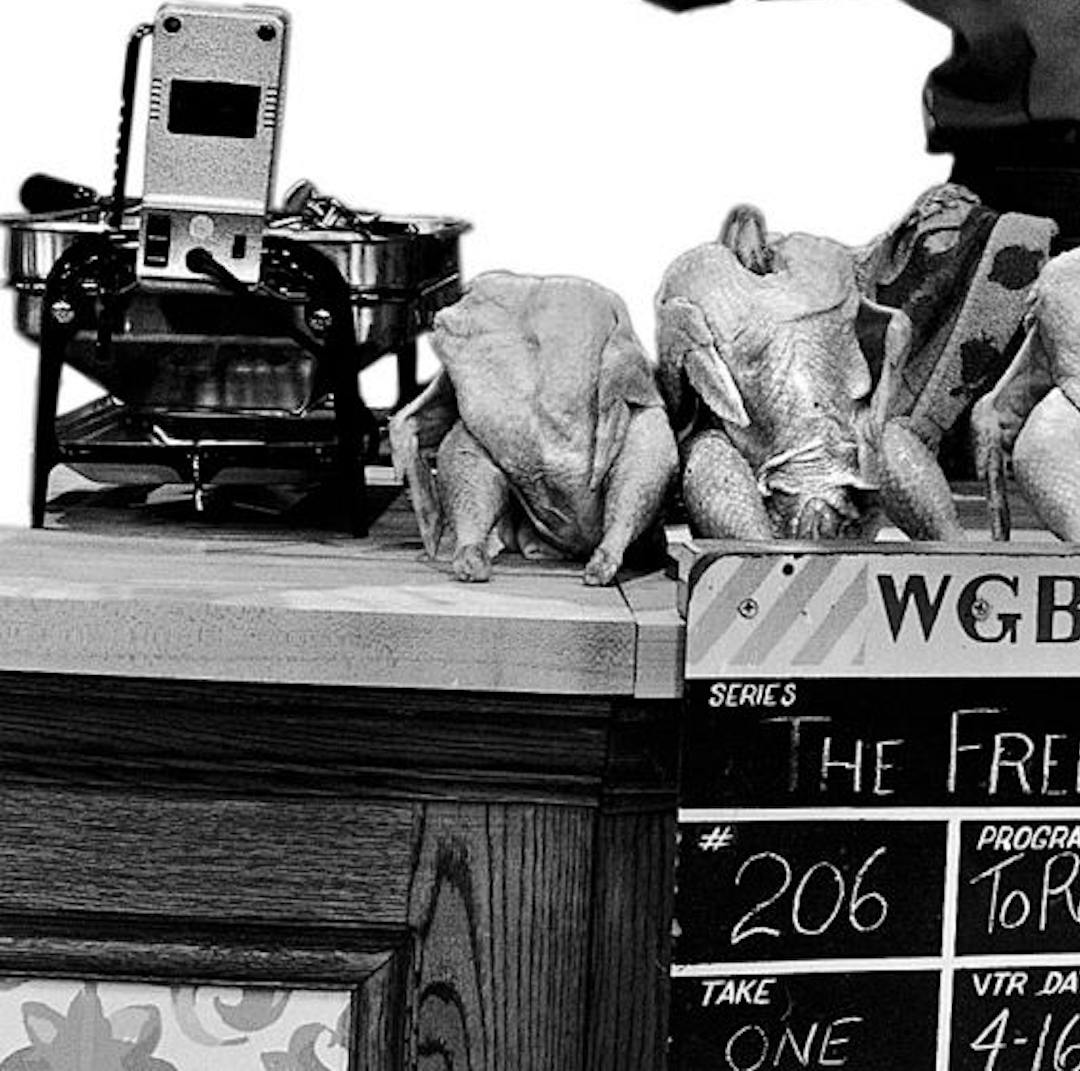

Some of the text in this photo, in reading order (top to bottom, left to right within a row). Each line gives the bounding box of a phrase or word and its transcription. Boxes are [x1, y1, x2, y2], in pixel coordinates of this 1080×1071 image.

[708, 681, 797, 708] SERIES
[760, 714, 905, 795] THE
[699, 825, 736, 852] #
[730, 846, 888, 945] 206
[701, 977, 778, 1007] TAKE
[972, 970, 1029, 997] VTR
[725, 1016, 865, 1071] ONE
